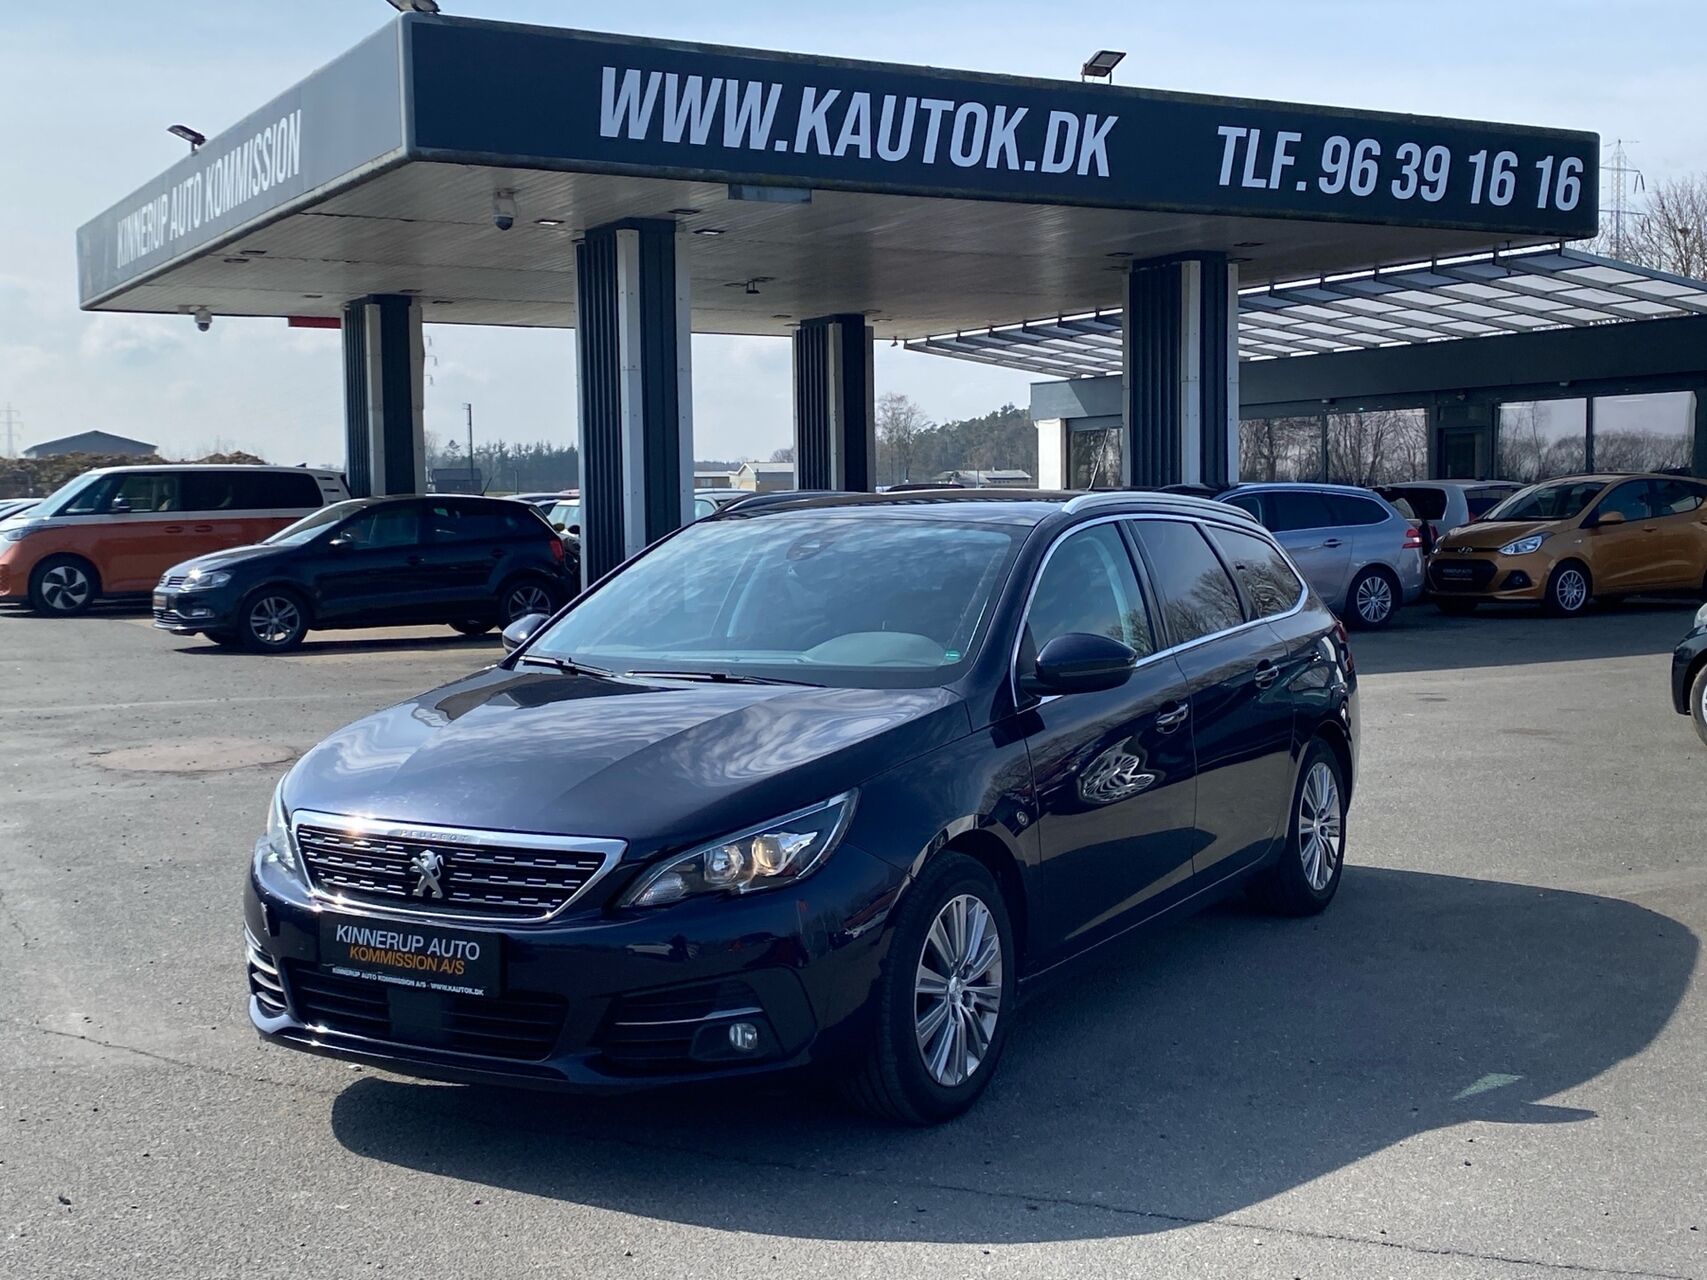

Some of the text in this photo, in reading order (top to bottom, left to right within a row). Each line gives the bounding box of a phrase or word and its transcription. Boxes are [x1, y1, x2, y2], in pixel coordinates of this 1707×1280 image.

[600, 66, 1118, 177] WWW.KAUTOK.DK
[117, 109, 301, 269] KINNERUP AUTO KOMMISSION
[1218, 125, 1584, 211] TLF. 96 39 16 16
[336, 924, 480, 961] KINNERUP AUTO
[349, 945, 465, 975] KOMMISSION A/S
